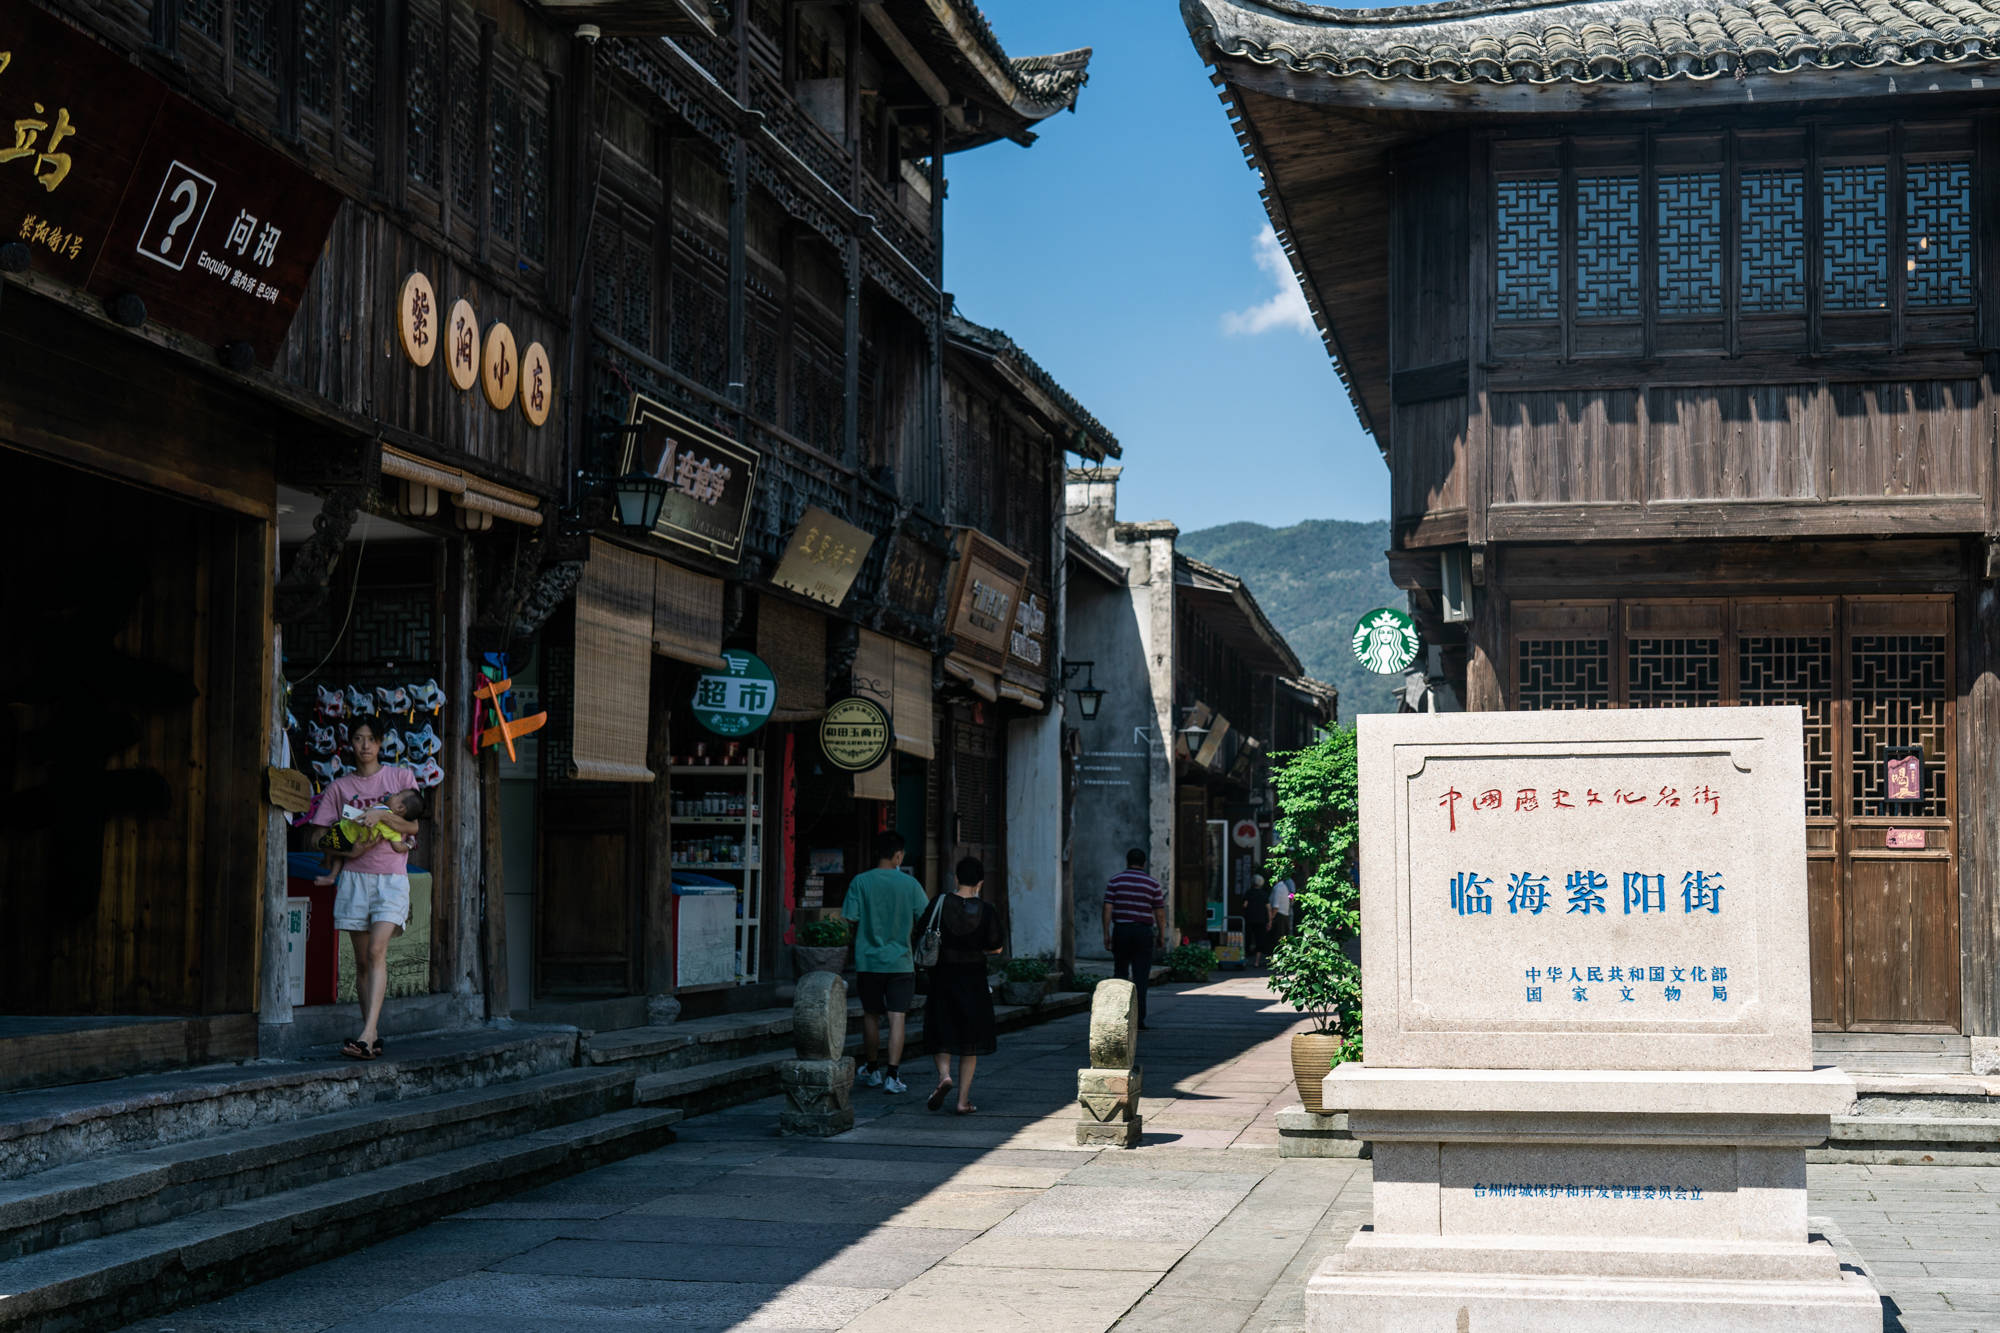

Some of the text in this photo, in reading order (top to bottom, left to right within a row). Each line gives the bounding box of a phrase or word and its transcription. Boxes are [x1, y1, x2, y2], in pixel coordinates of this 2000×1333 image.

[18, 213, 84, 261] 紫阳街1号
[224, 207, 282, 268] 问讯
[197, 250, 232, 281] Enquiry
[230, 269, 257, 294] 案内所
[412, 287, 544, 412] 紫阳小店
[697, 679, 768, 711] 超市
[1450, 870, 1726, 915] 临海紫阳街
[1525, 966, 1728, 983] 中华人民共和国文化部
[1526, 986, 1728, 1003] 国家文物局
[1473, 1182, 1704, 1201] 台州府城保护和开发管理委员会立
